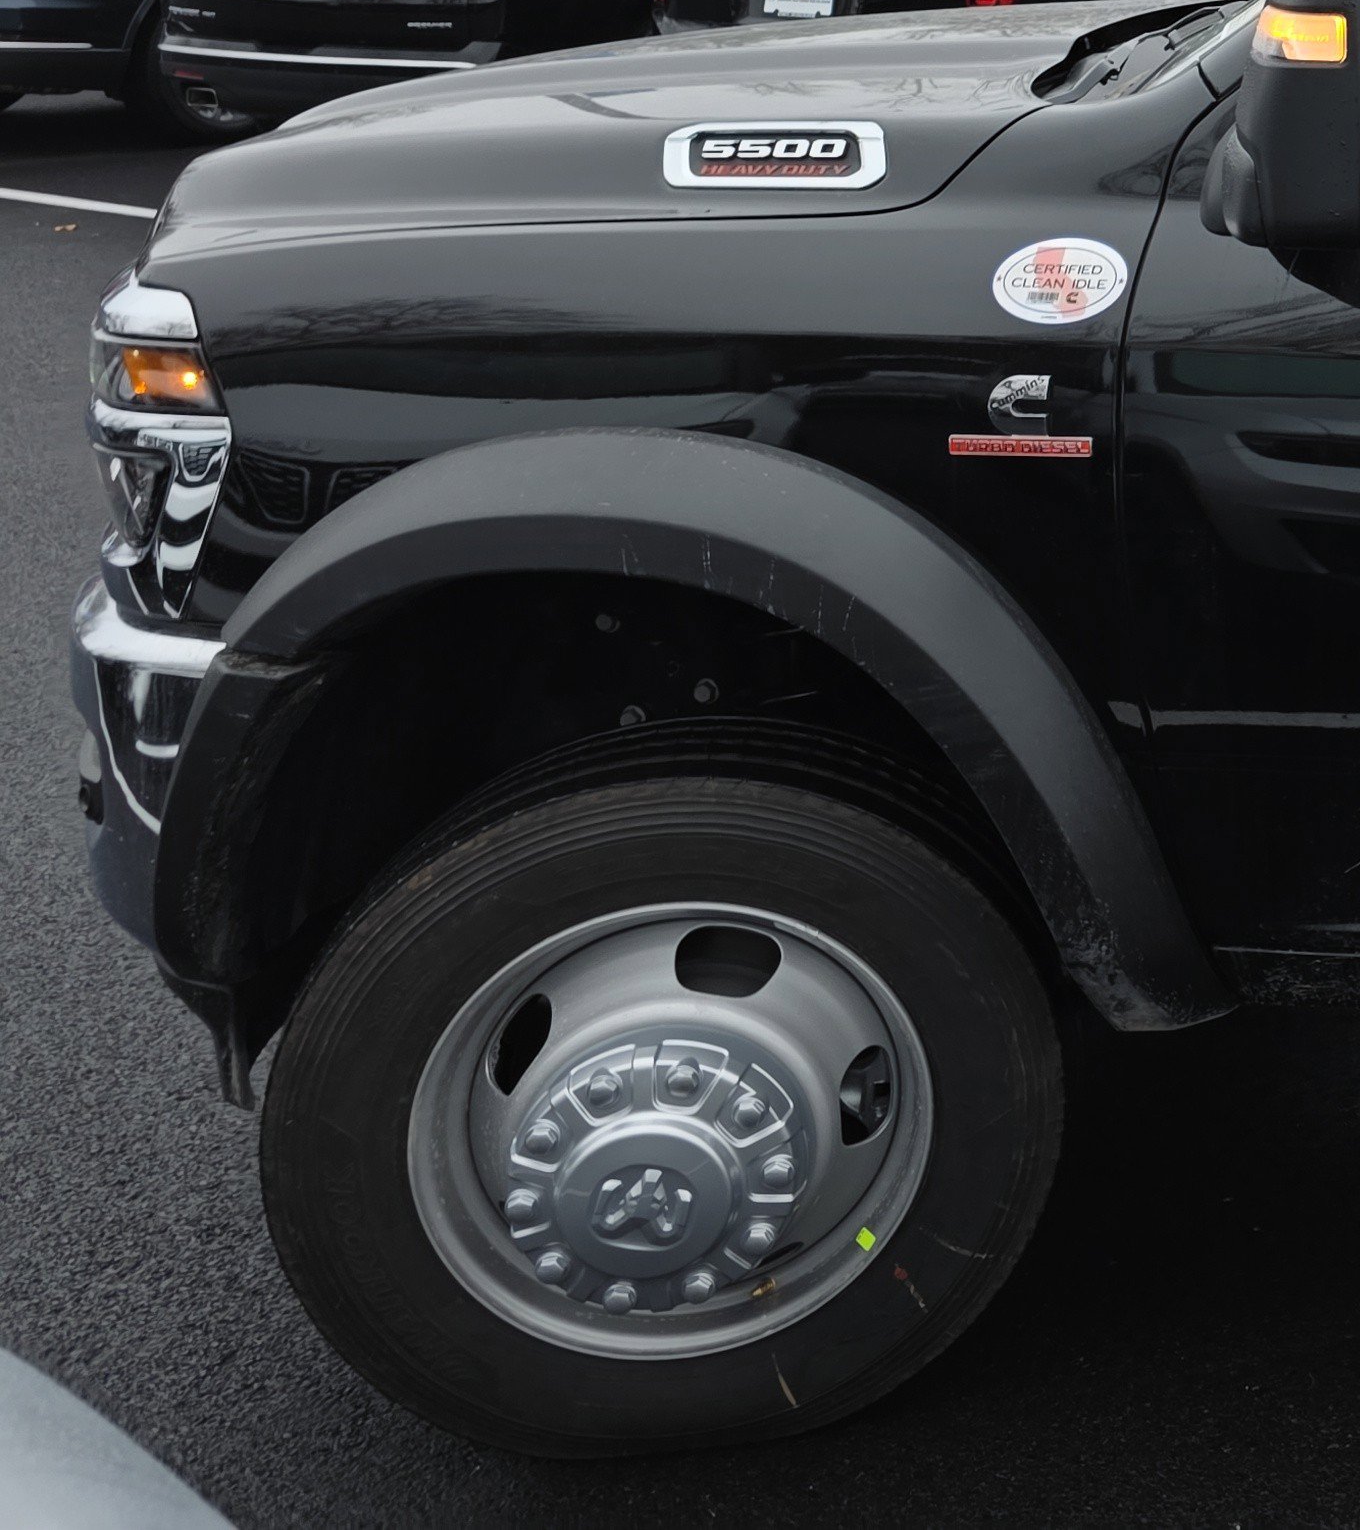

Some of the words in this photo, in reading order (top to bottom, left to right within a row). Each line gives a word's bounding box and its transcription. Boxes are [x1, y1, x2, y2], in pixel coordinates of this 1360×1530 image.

[700, 138, 848, 160] 5500
[700, 163, 779, 176] HEAVY
[781, 163, 850, 176] DUTY
[1022, 263, 1103, 276] CERTIFIED
[1011, 277, 1065, 289] CLEAN
[1071, 278, 1108, 291] IDLE
[990, 375, 1045, 410] Cummins
[951, 438, 1017, 453] TURBO
[1019, 440, 1091, 455] DIESEL
